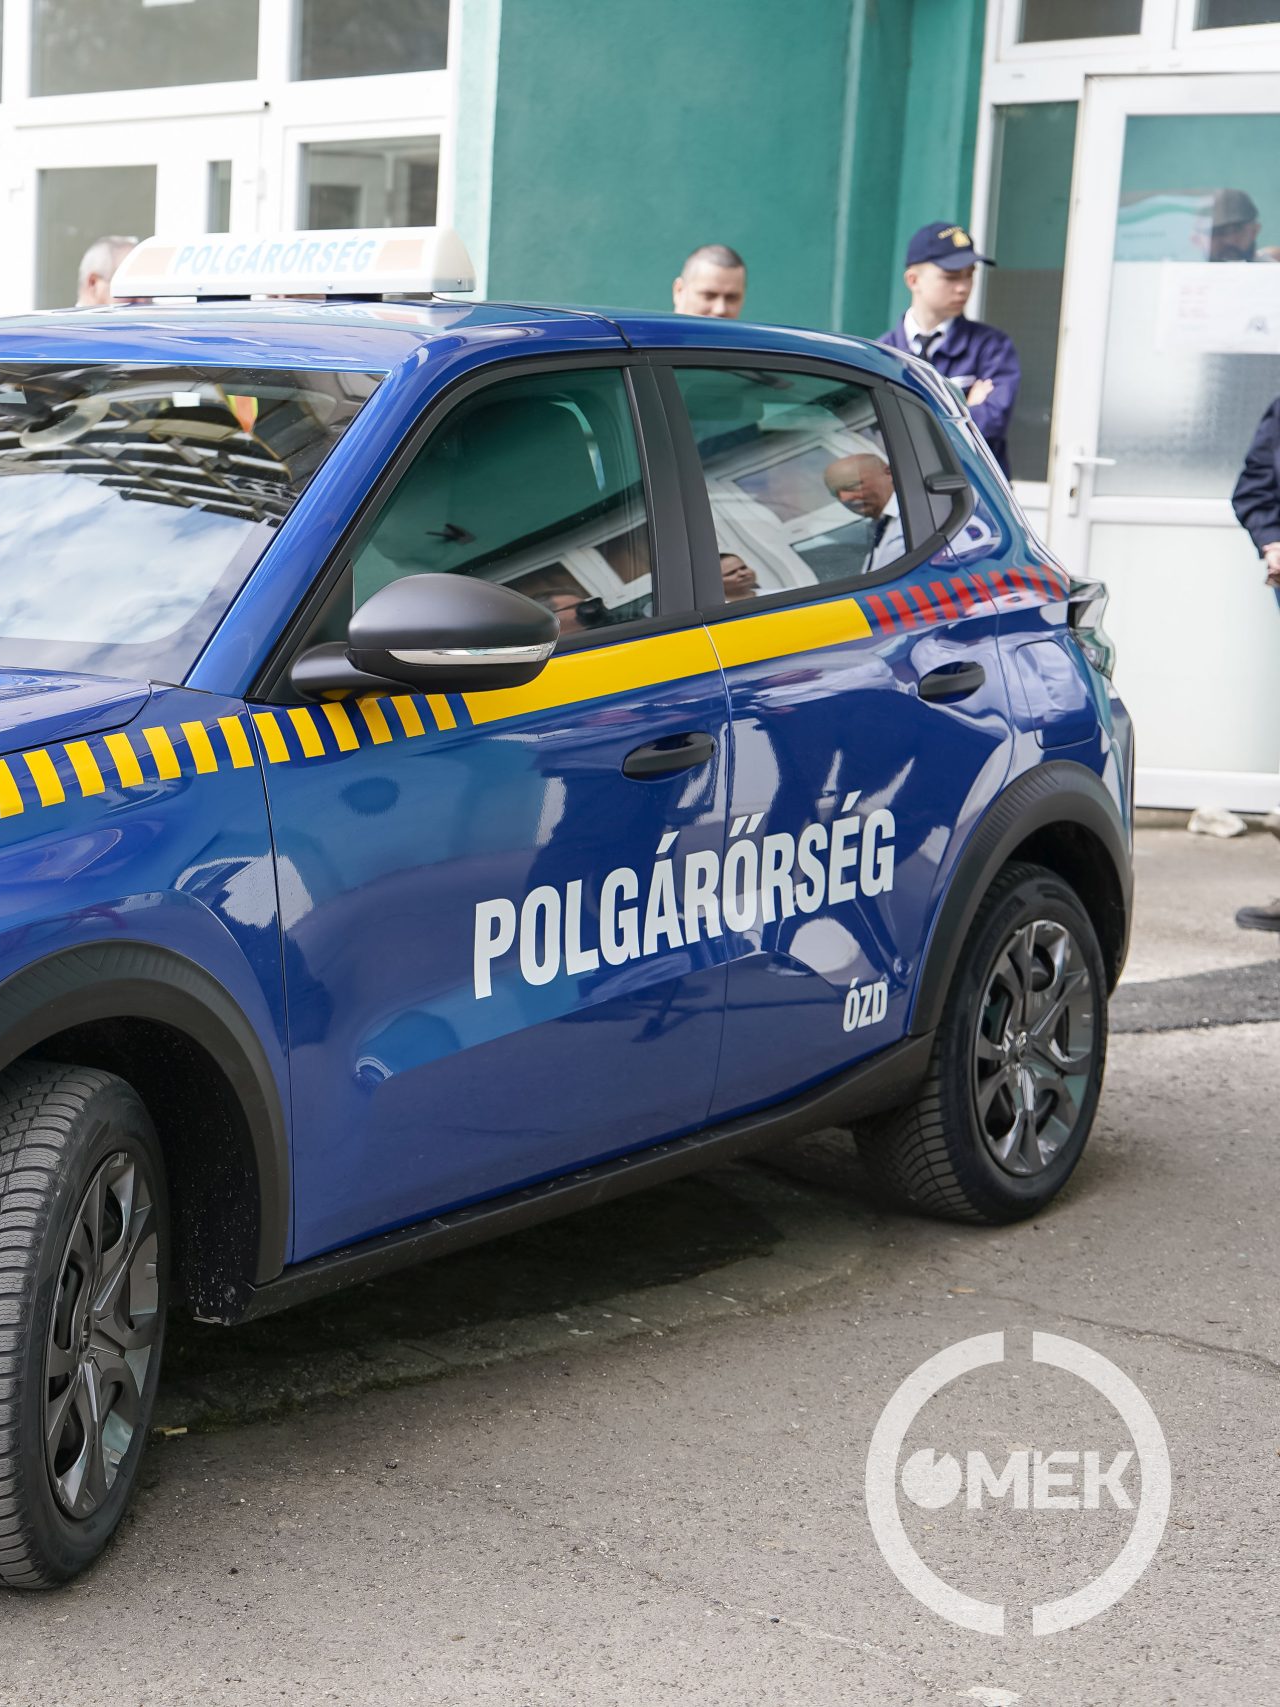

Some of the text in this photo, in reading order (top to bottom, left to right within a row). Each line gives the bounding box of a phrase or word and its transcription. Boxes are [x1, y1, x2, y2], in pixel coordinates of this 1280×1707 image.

[173, 237, 377, 275] POLGÁRŐRSÉG
[473, 790, 896, 1000] POLGÁRŐRSÉG
[842, 977, 888, 1033] ÓZD
